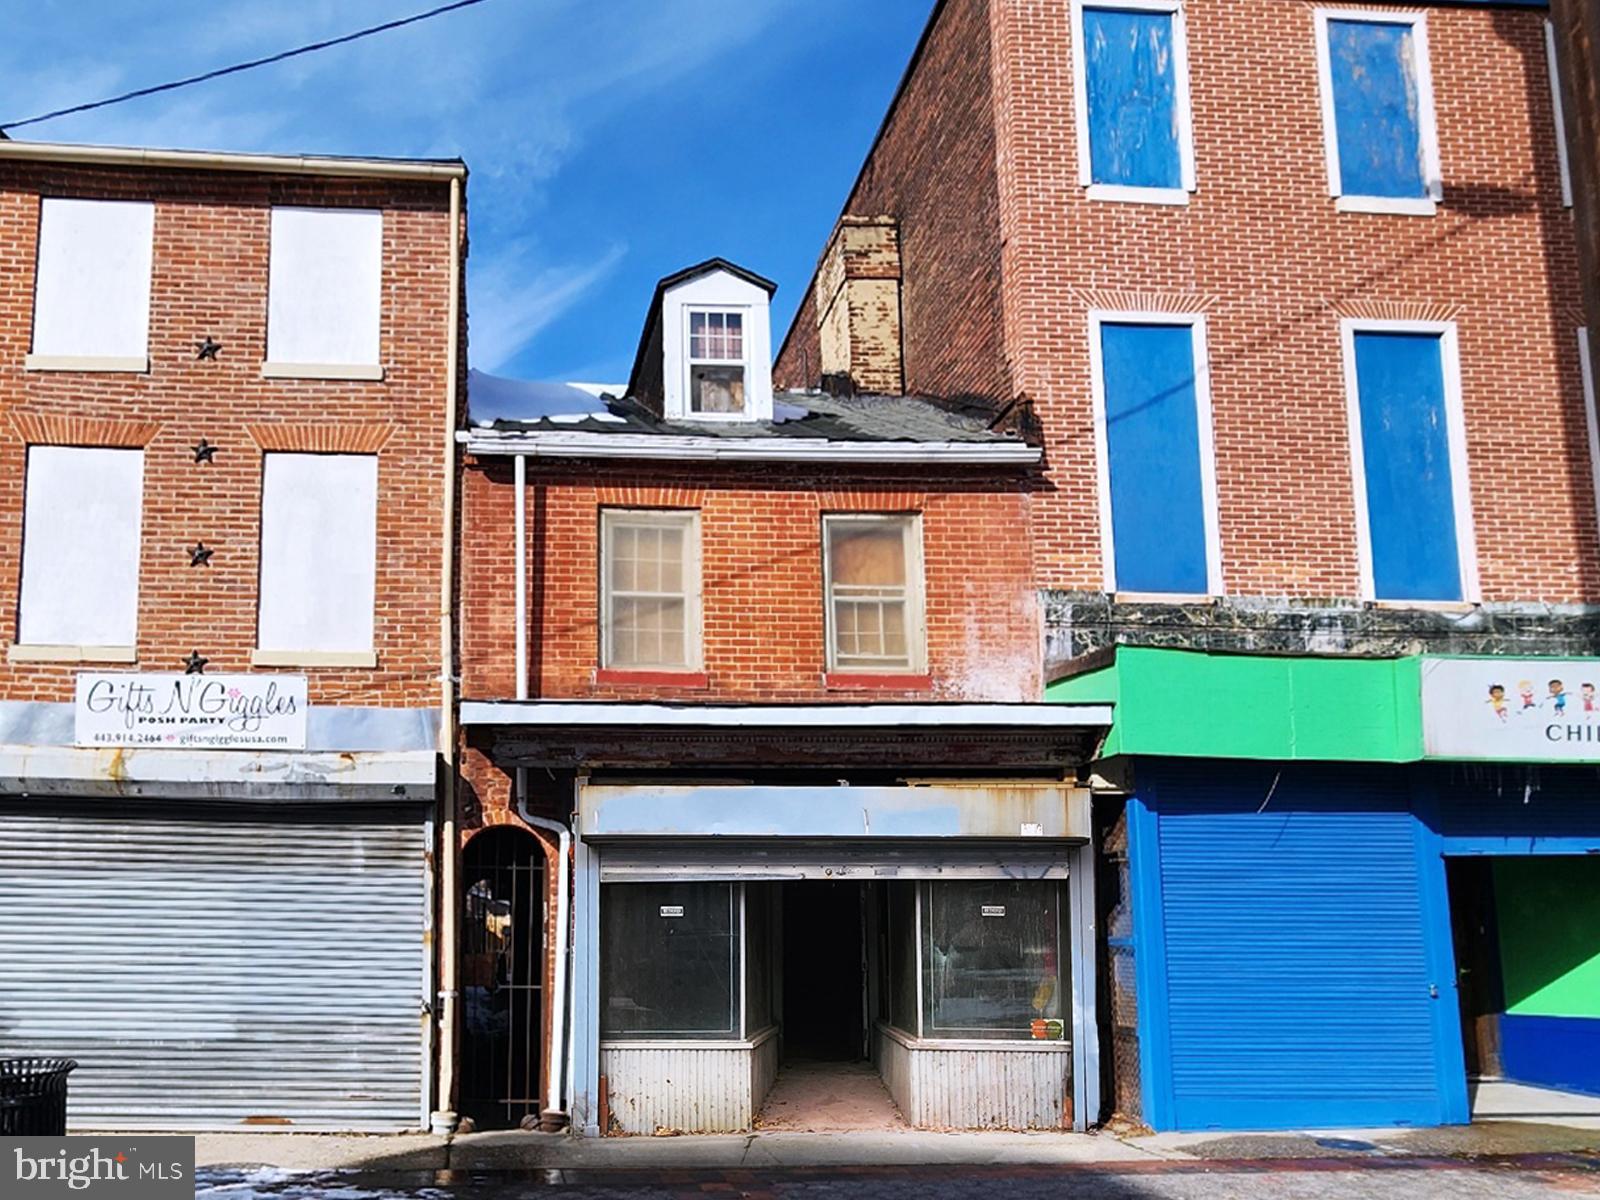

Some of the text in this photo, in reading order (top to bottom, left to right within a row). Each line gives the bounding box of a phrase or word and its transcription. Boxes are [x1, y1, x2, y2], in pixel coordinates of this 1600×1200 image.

[87, 680, 156, 729] Gifts
[138, 716, 226, 724] POSH PARTY
[1545, 723, 1600, 742] CHI
